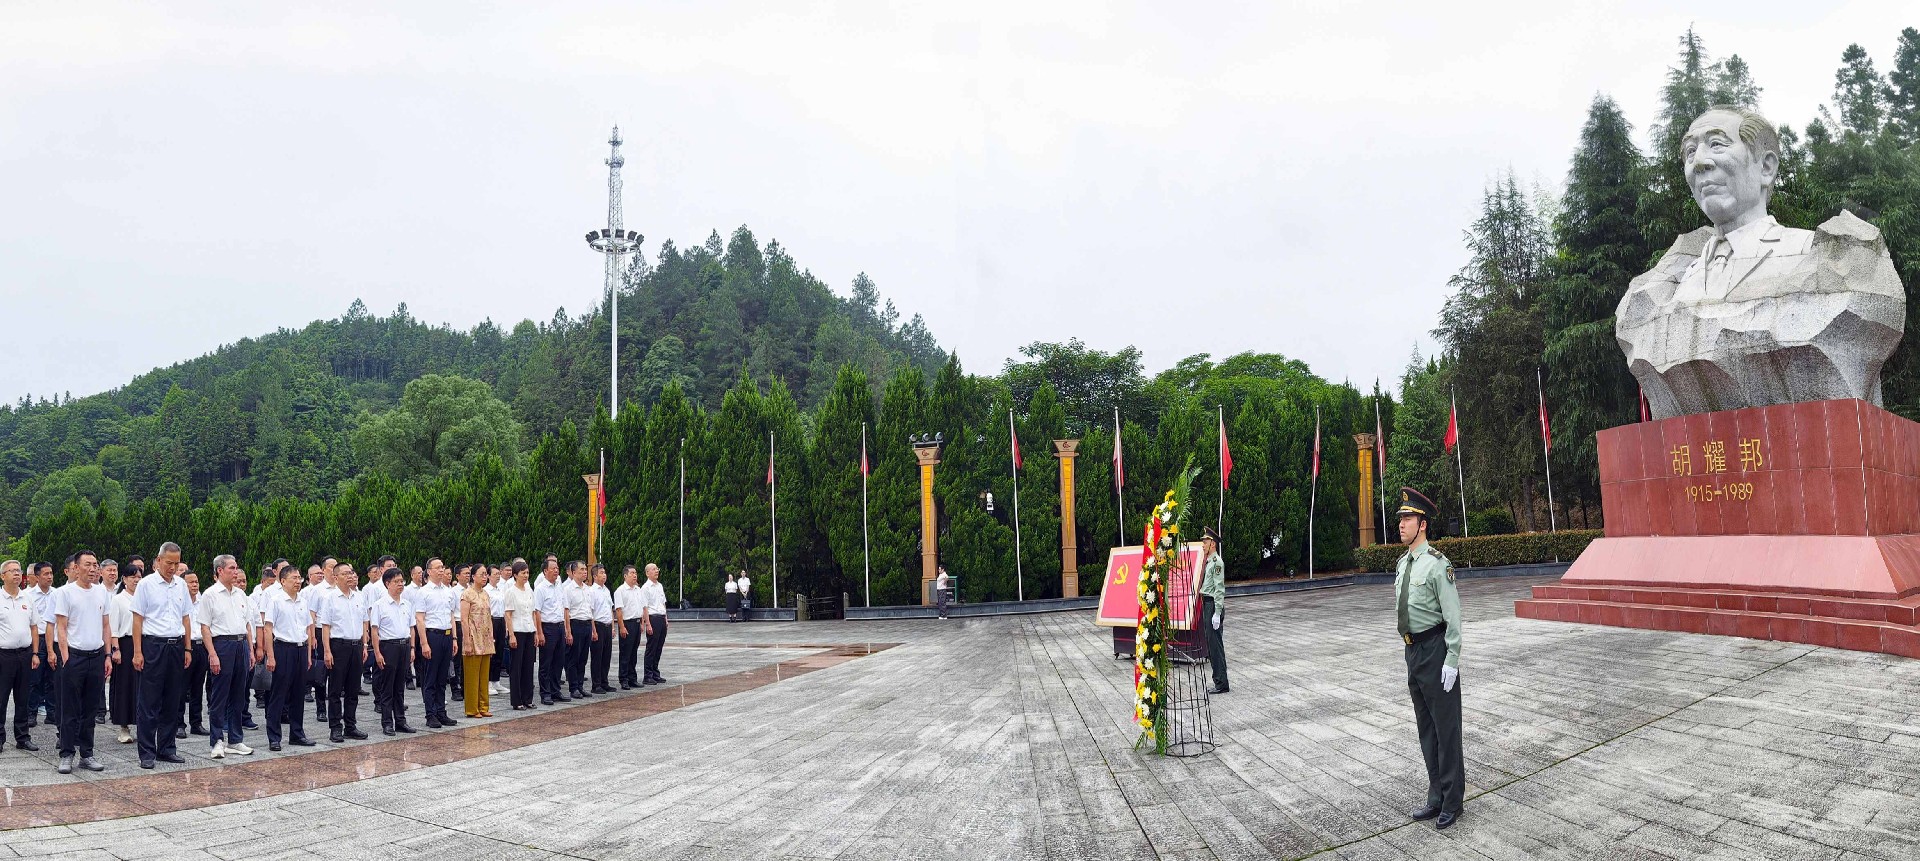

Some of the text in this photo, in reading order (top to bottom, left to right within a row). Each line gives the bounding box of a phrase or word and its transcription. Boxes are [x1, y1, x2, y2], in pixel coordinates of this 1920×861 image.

[1670, 438, 1763, 477] 胡耀邦
[1684, 483, 1753, 502] 1915-1989
